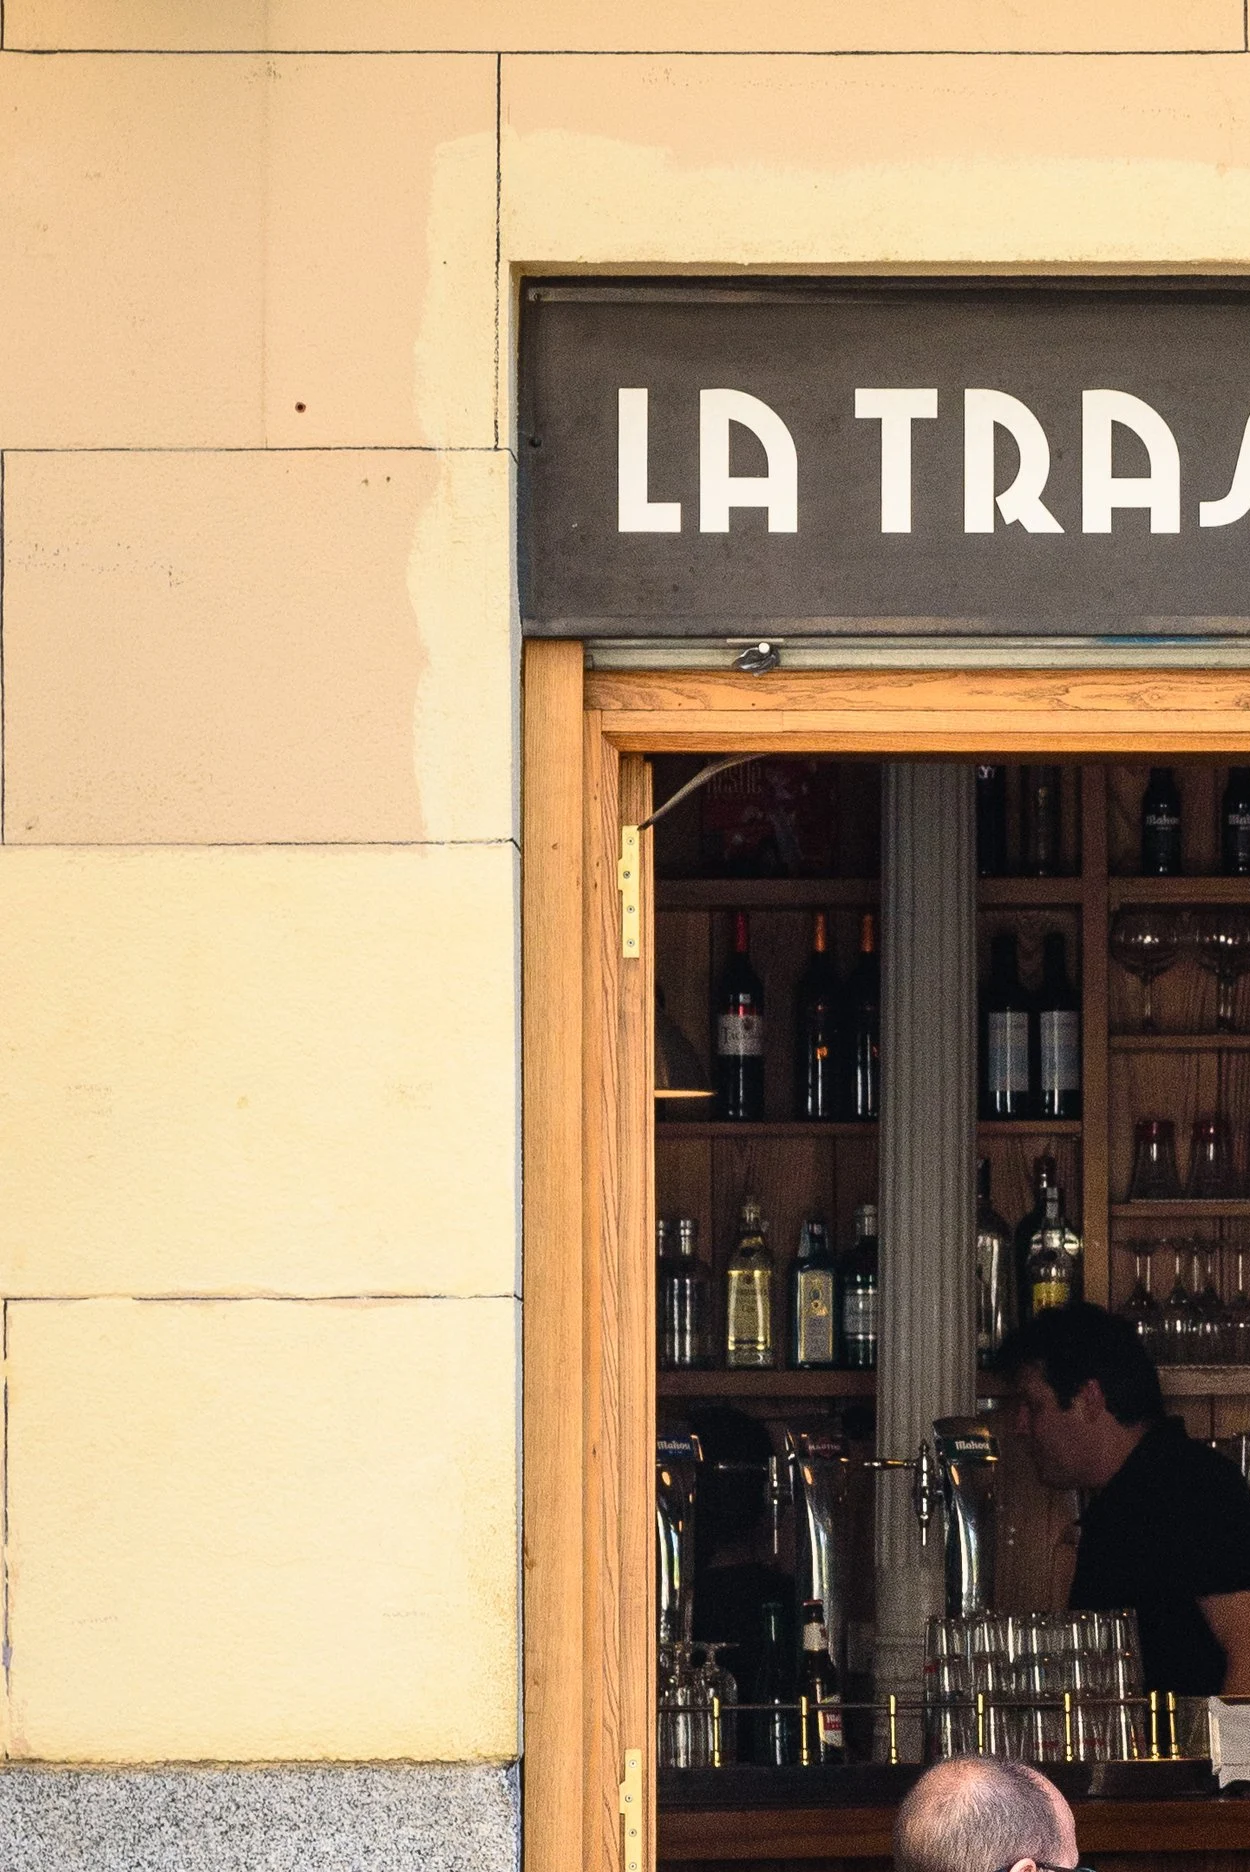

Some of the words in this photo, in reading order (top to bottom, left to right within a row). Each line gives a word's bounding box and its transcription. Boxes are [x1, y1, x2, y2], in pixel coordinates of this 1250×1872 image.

[618, 388, 798, 534] LA
[657, 1440, 691, 1450] Mahou
[955, 1440, 990, 1450] Mahou
